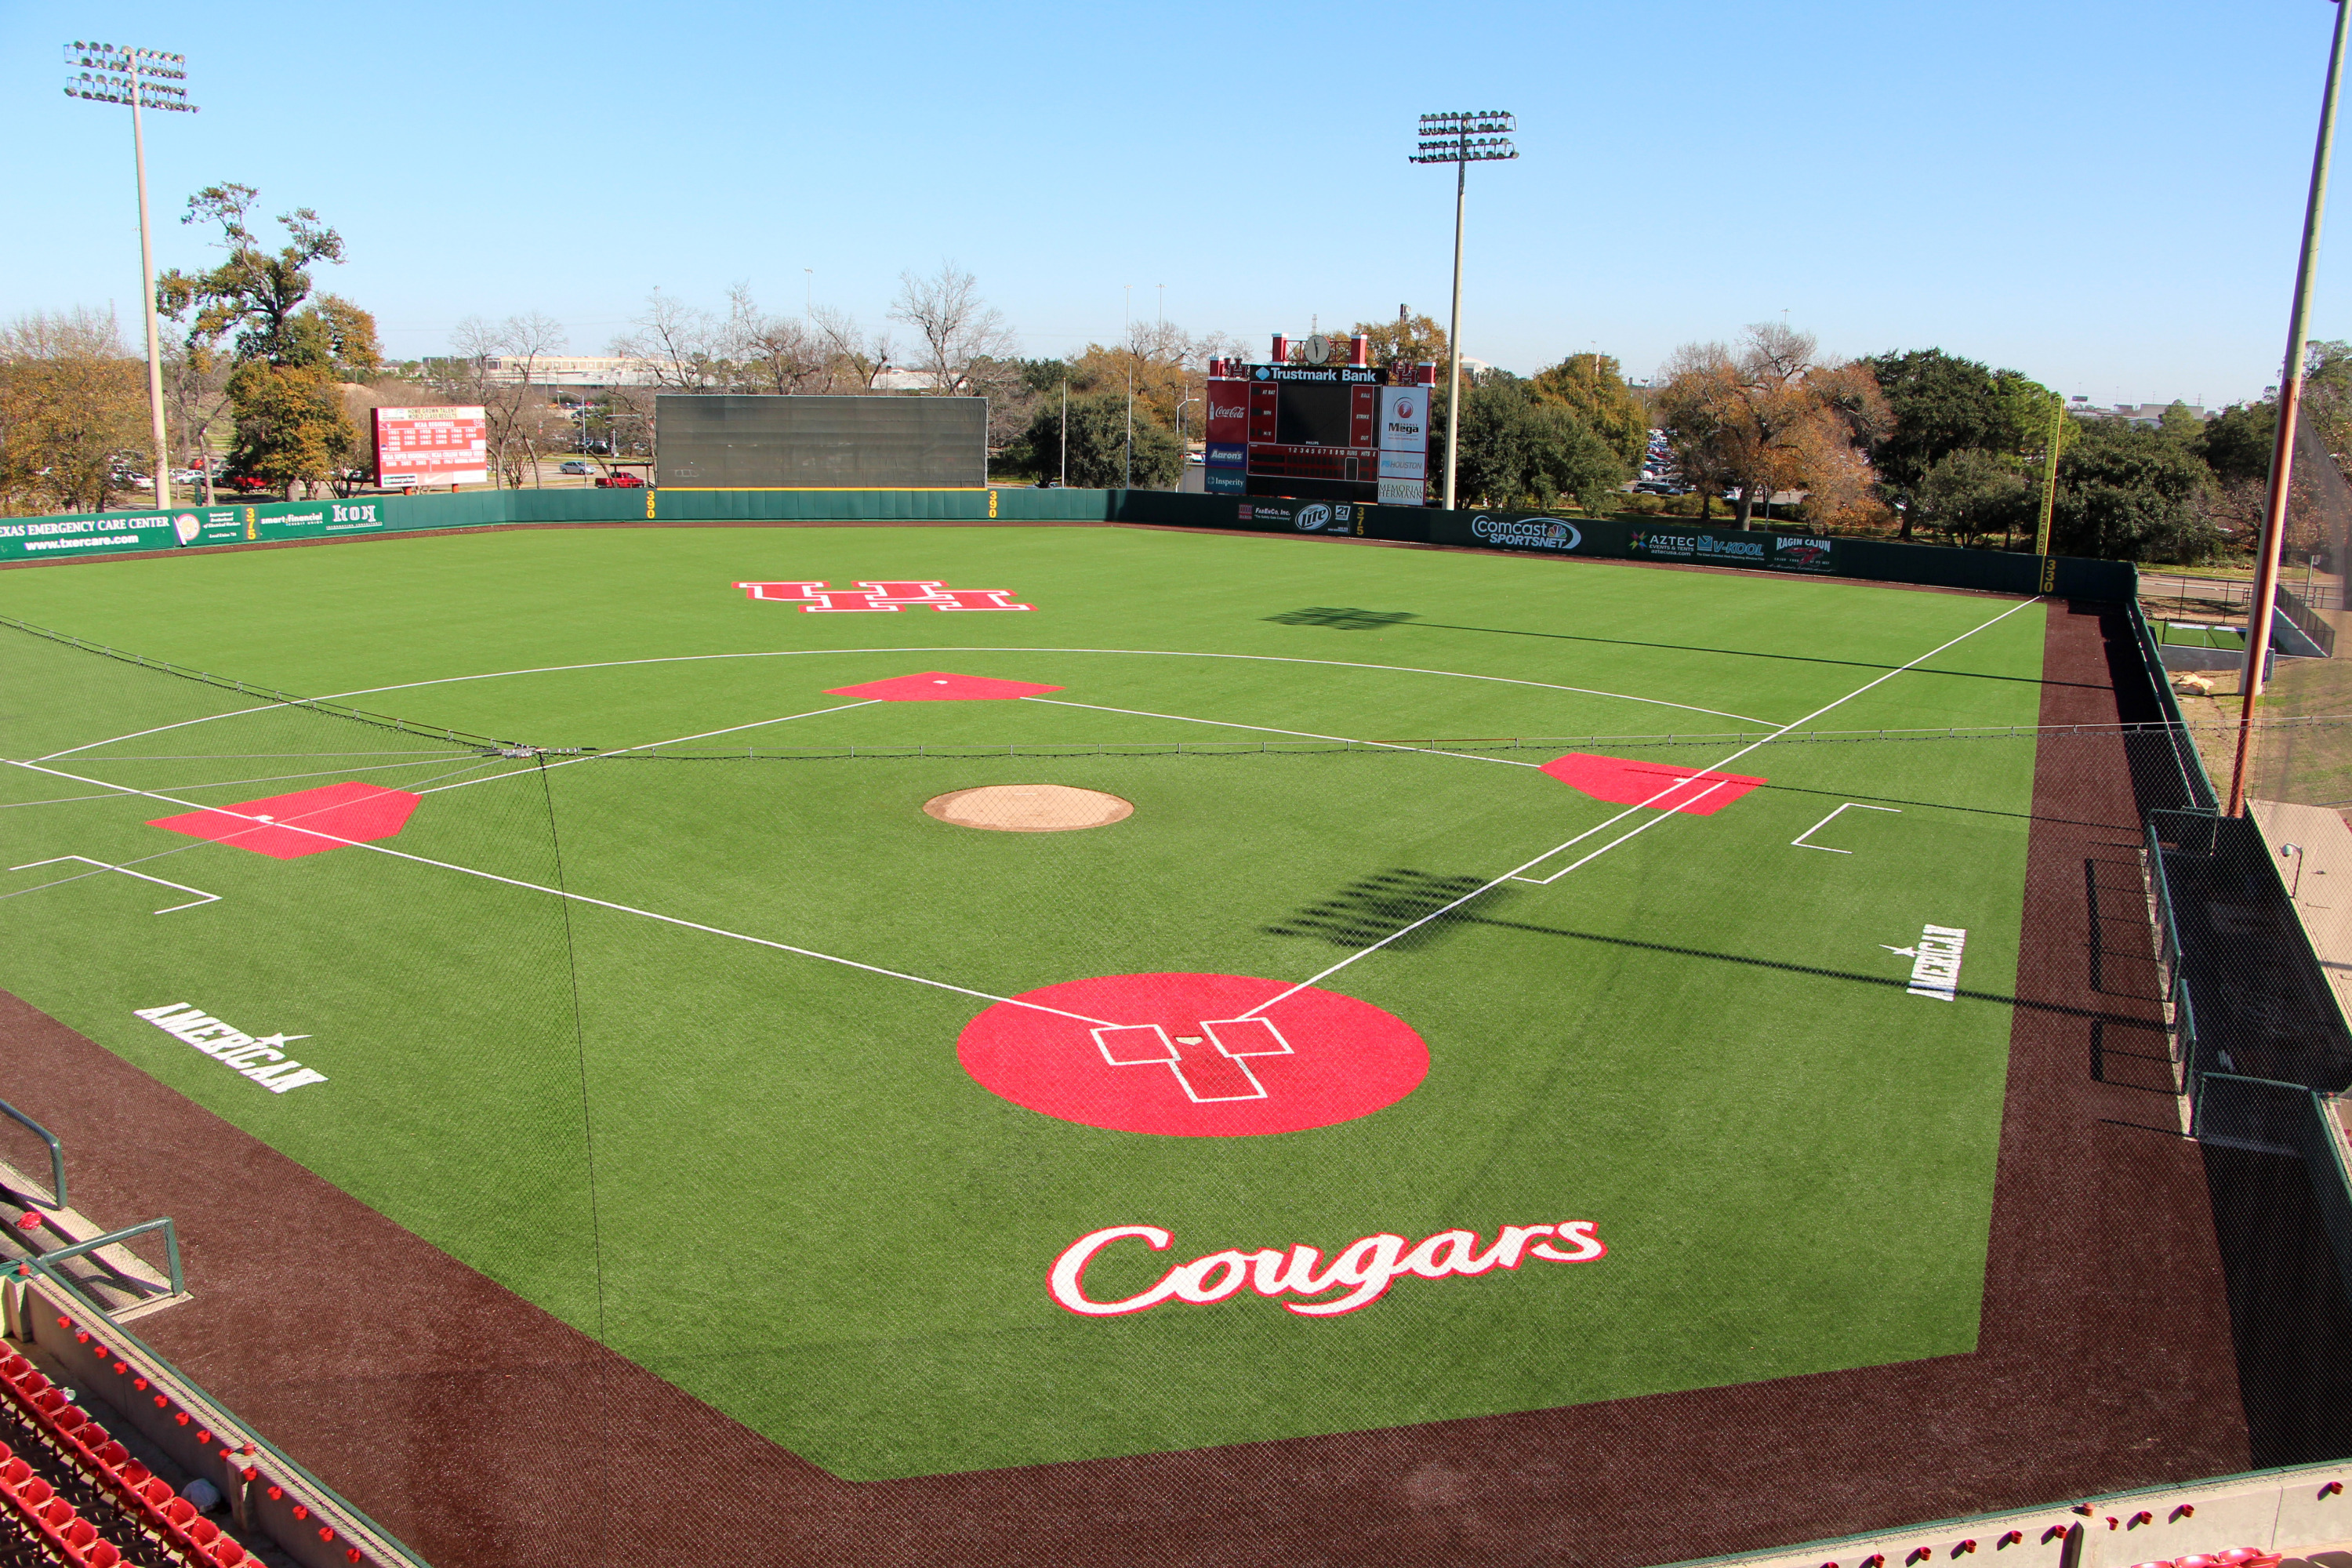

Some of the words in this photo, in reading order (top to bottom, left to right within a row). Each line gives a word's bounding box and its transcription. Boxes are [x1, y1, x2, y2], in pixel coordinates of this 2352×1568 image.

[1271, 367, 1337, 381] Trustmark
[1342, 369, 1376, 382] Bank
[1215, 407, 1245, 419] Coca-Cola
[1389, 423, 1419, 434] Mega
[1211, 450, 1242, 460] Aaron's
[1390, 461, 1422, 469] HOUSTON
[1215, 477, 1244, 487] Insperity
[1379, 484, 1423, 493] MEMORIAL
[1379, 490, 1422, 499] HERMANN
[646, 490, 655, 519] 390
[989, 490, 997, 519] 390
[1337, 506, 1349, 515] 21
[246, 507, 256, 540] 375
[1301, 509, 1327, 529] Lite
[2038, 477, 2052, 555] TXERCARE.COM
[27, 521, 95, 536] EMERGENCY
[97, 519, 127, 531] CARE
[128, 517, 170, 529] CENTER
[1472, 517, 1547, 537] Comcast
[24, 535, 139, 550] www.txercare.com
[1490, 534, 1566, 548] SPORTSNET
[1650, 535, 1694, 547] AZTEC
[1713, 541, 1764, 556] V-KOOL
[1776, 537, 1803, 551] RAGIN
[1805, 539, 1831, 552] CAJUN
[2044, 559, 2056, 592] 330
[731, 581, 1038, 613] UH
[132, 1002, 330, 1094] AMERICAN
[1046, 1220, 1607, 1317] Cougars
